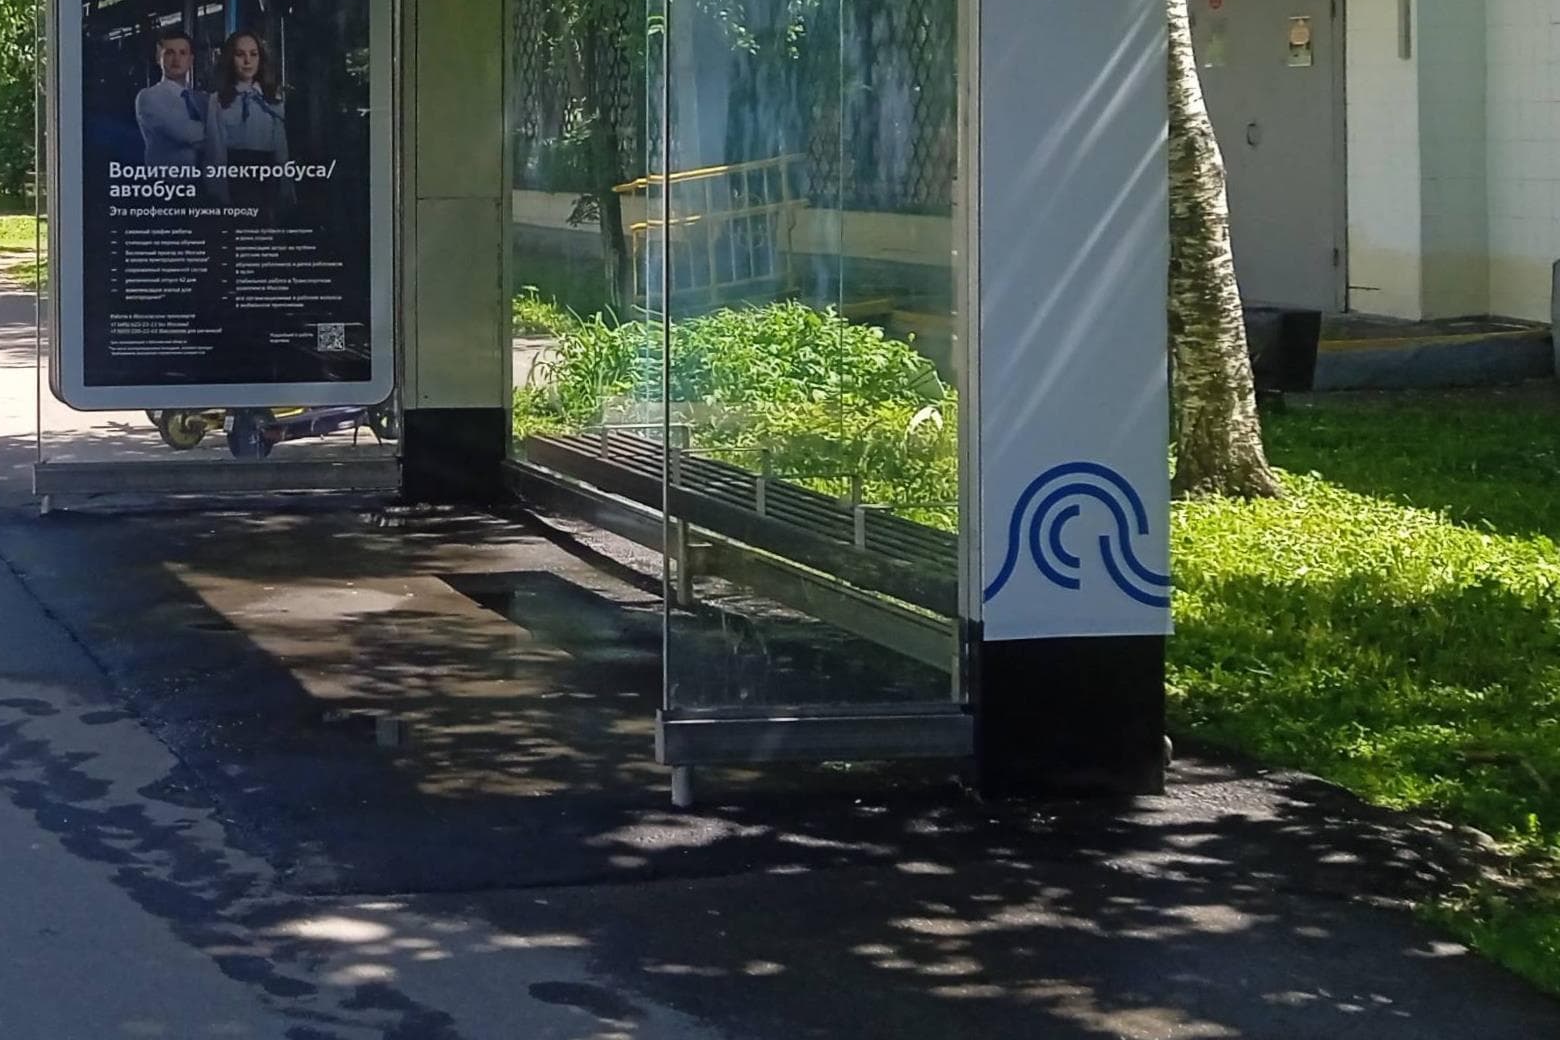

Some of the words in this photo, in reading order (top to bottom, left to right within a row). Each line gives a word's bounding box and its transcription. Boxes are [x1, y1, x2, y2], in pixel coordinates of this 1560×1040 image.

[109, 162, 202, 181] Водитель
[205, 160, 337, 181] электробуса/
[109, 181, 196, 201] автобуса
[109, 206, 128, 216] Эта
[129, 206, 187, 218] профессия
[188, 207, 221, 218] нужна
[223, 207, 259, 218] городу
